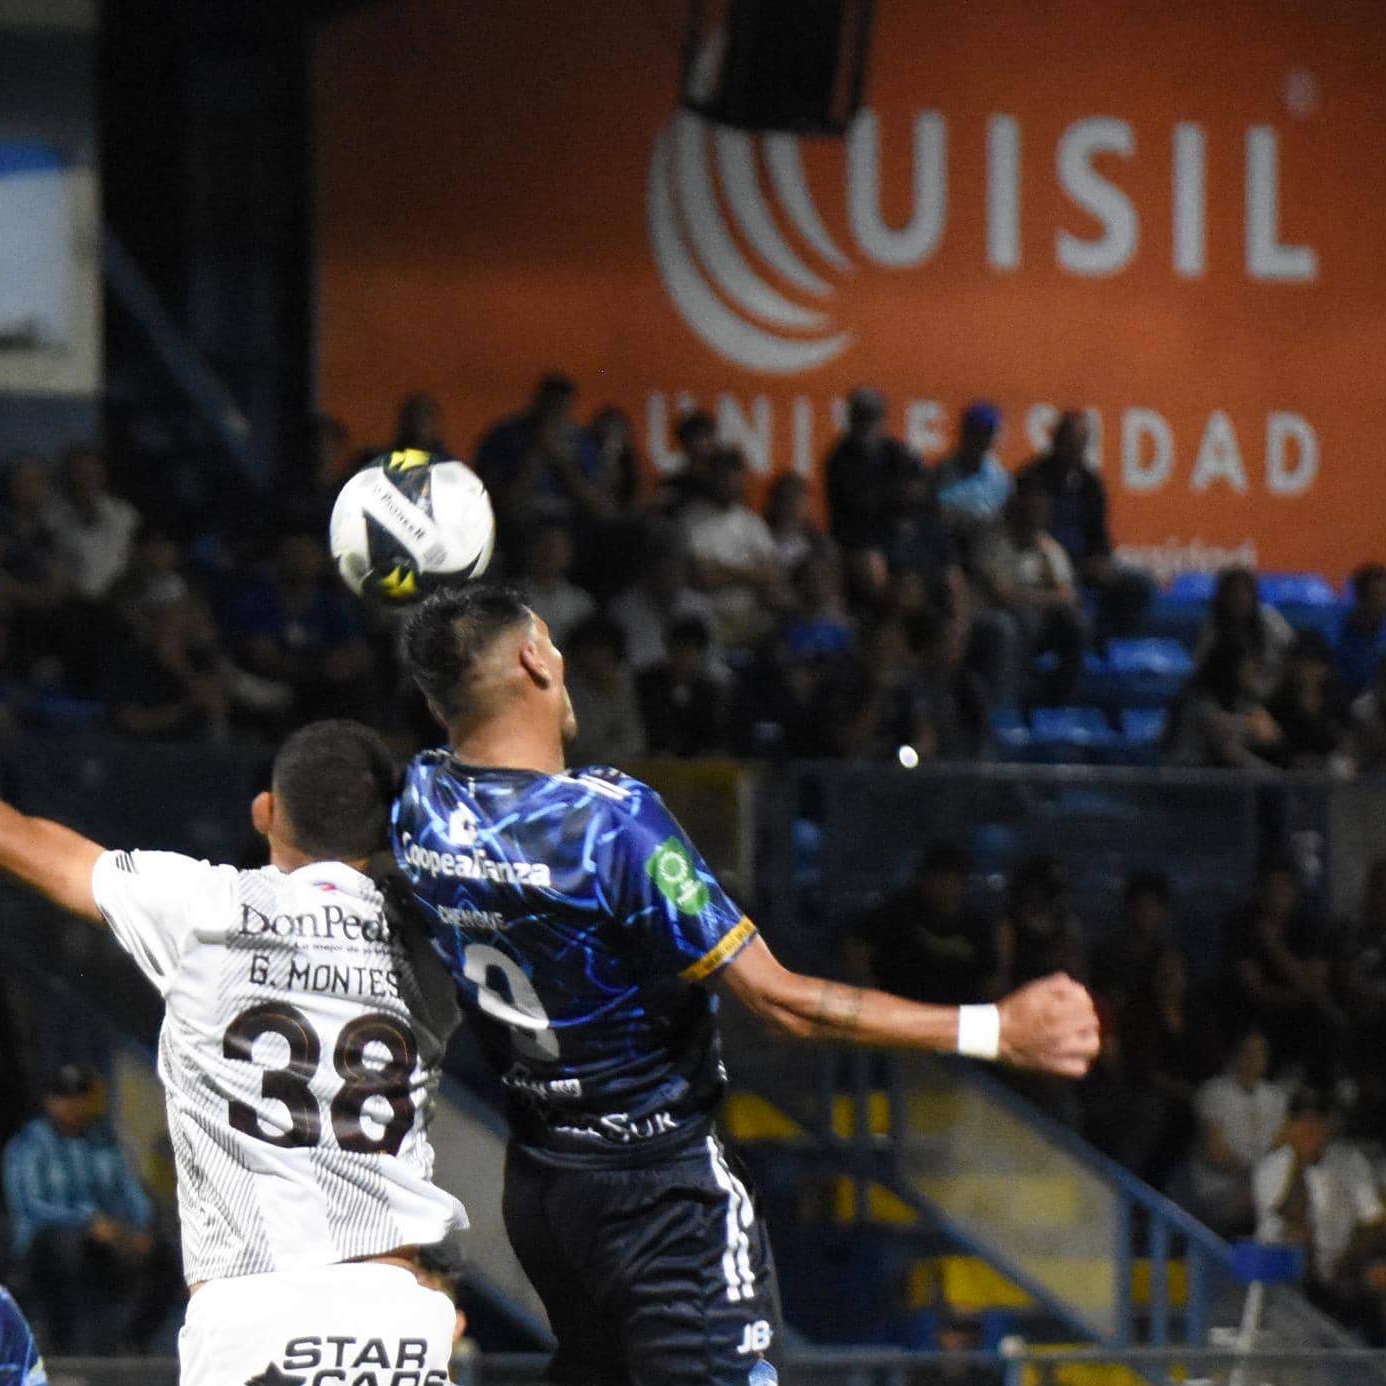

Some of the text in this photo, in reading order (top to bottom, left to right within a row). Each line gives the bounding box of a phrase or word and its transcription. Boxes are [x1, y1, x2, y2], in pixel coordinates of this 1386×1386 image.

[845, 108, 1319, 282] UISIL
[238, 903, 390, 944] DonPed
[222, 1001, 415, 1155] 38
[284, 1338, 428, 1371] STAR
